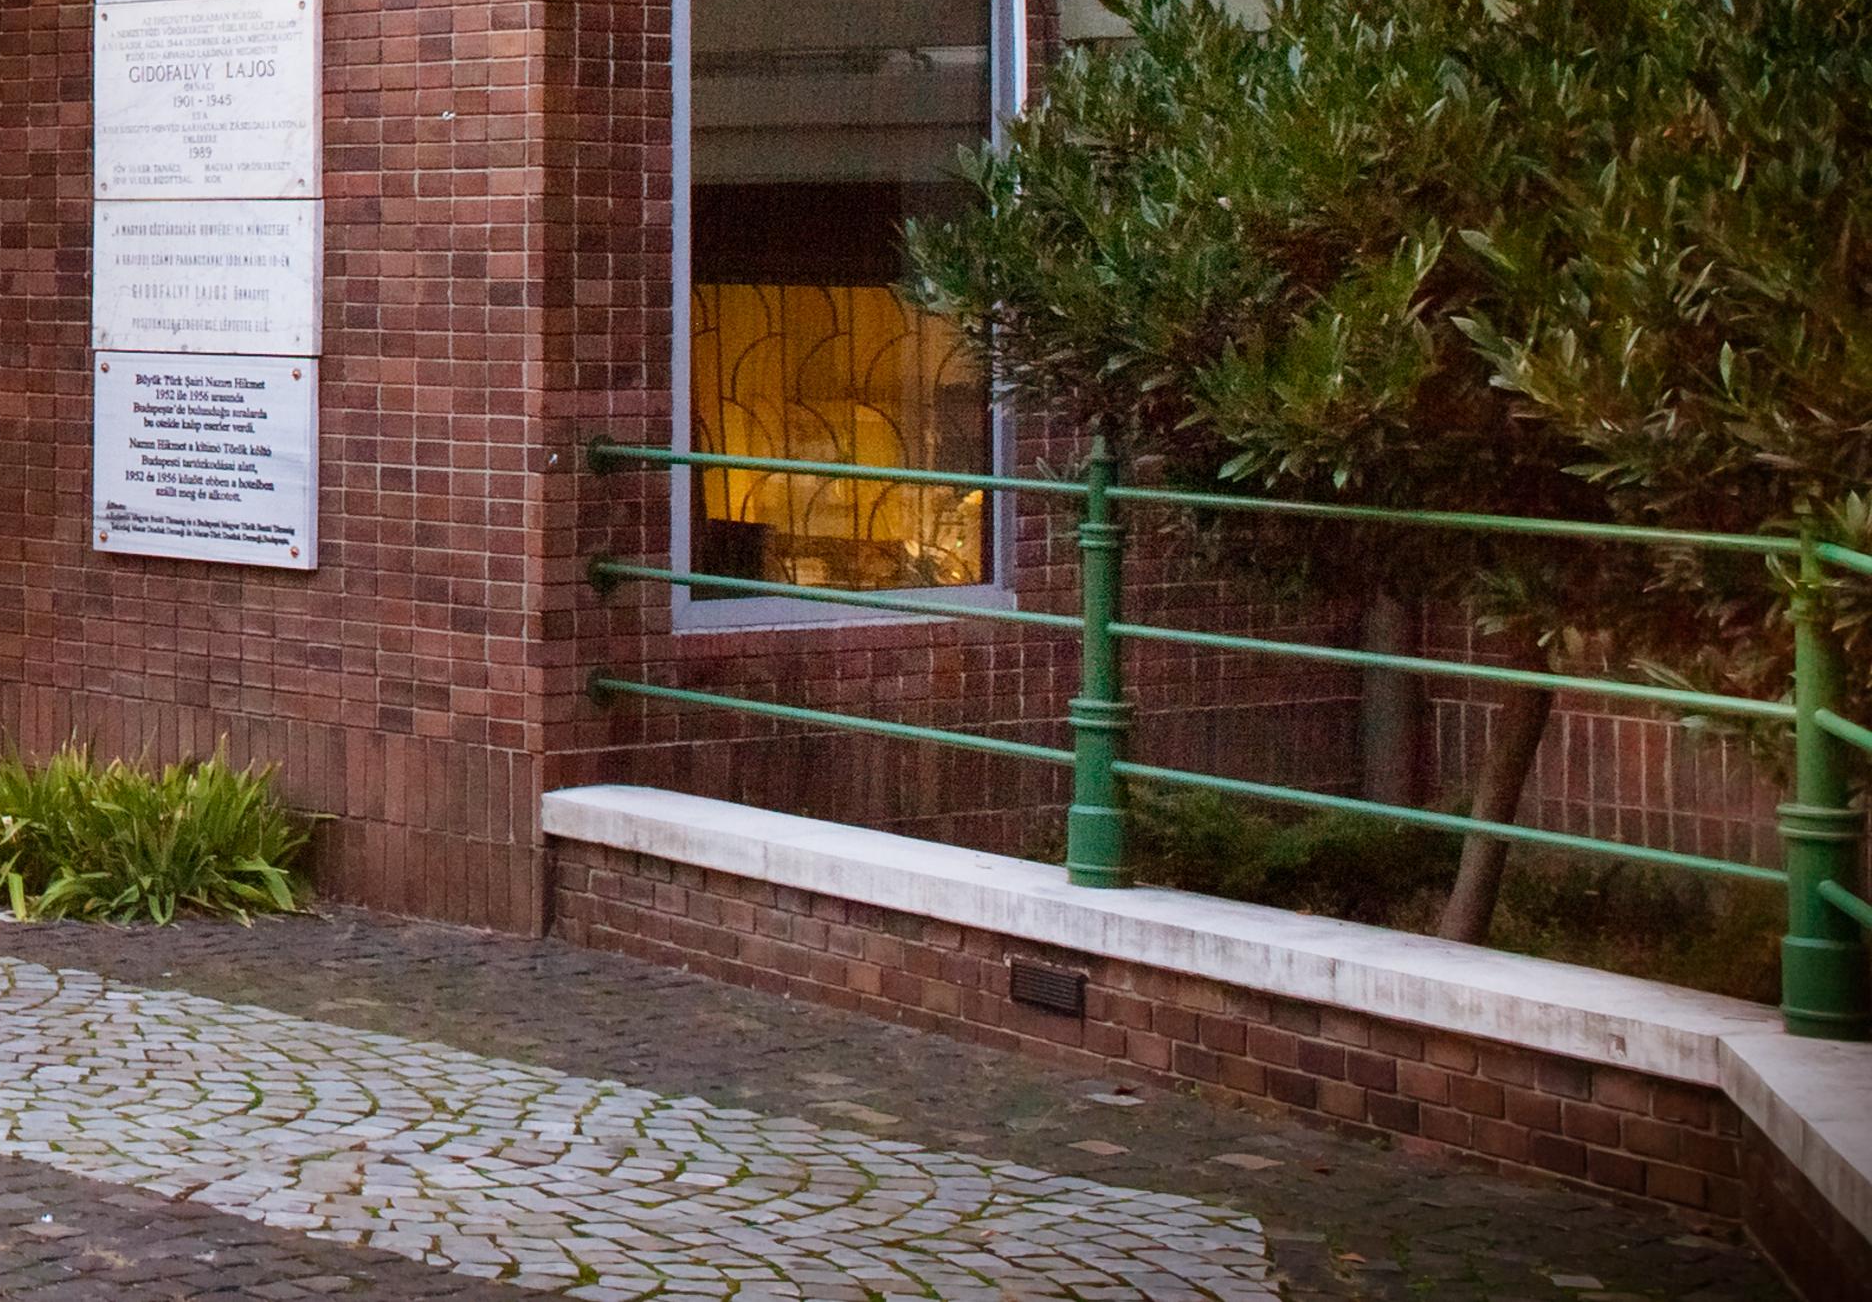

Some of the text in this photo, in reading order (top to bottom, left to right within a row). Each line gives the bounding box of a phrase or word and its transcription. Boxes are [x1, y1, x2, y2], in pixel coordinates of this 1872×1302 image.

[129, 59, 276, 83] GIDÓFALVY LAJOS
[173, 96, 194, 108] 1901
[206, 95, 232, 106] 1945
[188, 146, 212, 158] 1989
[121, 224, 147, 236] MAGYAR
[195, 285, 228, 301] LAJOS
[164, 375, 182, 386] Türk
[234, 378, 265, 390] Hikmet
[156, 389, 174, 400] 1952
[177, 390, 187, 400] ile
[190, 391, 209, 401] 1956
[144, 417, 153, 427] bu
[203, 421, 230, 432] eserler
[157, 439, 187, 451] Hikmet
[223, 443, 247, 455] Török
[141, 454, 180, 469] Budapesti
[125, 470, 144, 482] 1952
[146, 471, 155, 482] és
[157, 472, 176, 483] 1956
[179, 473, 203, 485] között
[205, 476, 229, 487] ebben
[238, 479, 274, 491] hotelben
[179, 490, 196, 501] meg
[198, 489, 206, 499] és
